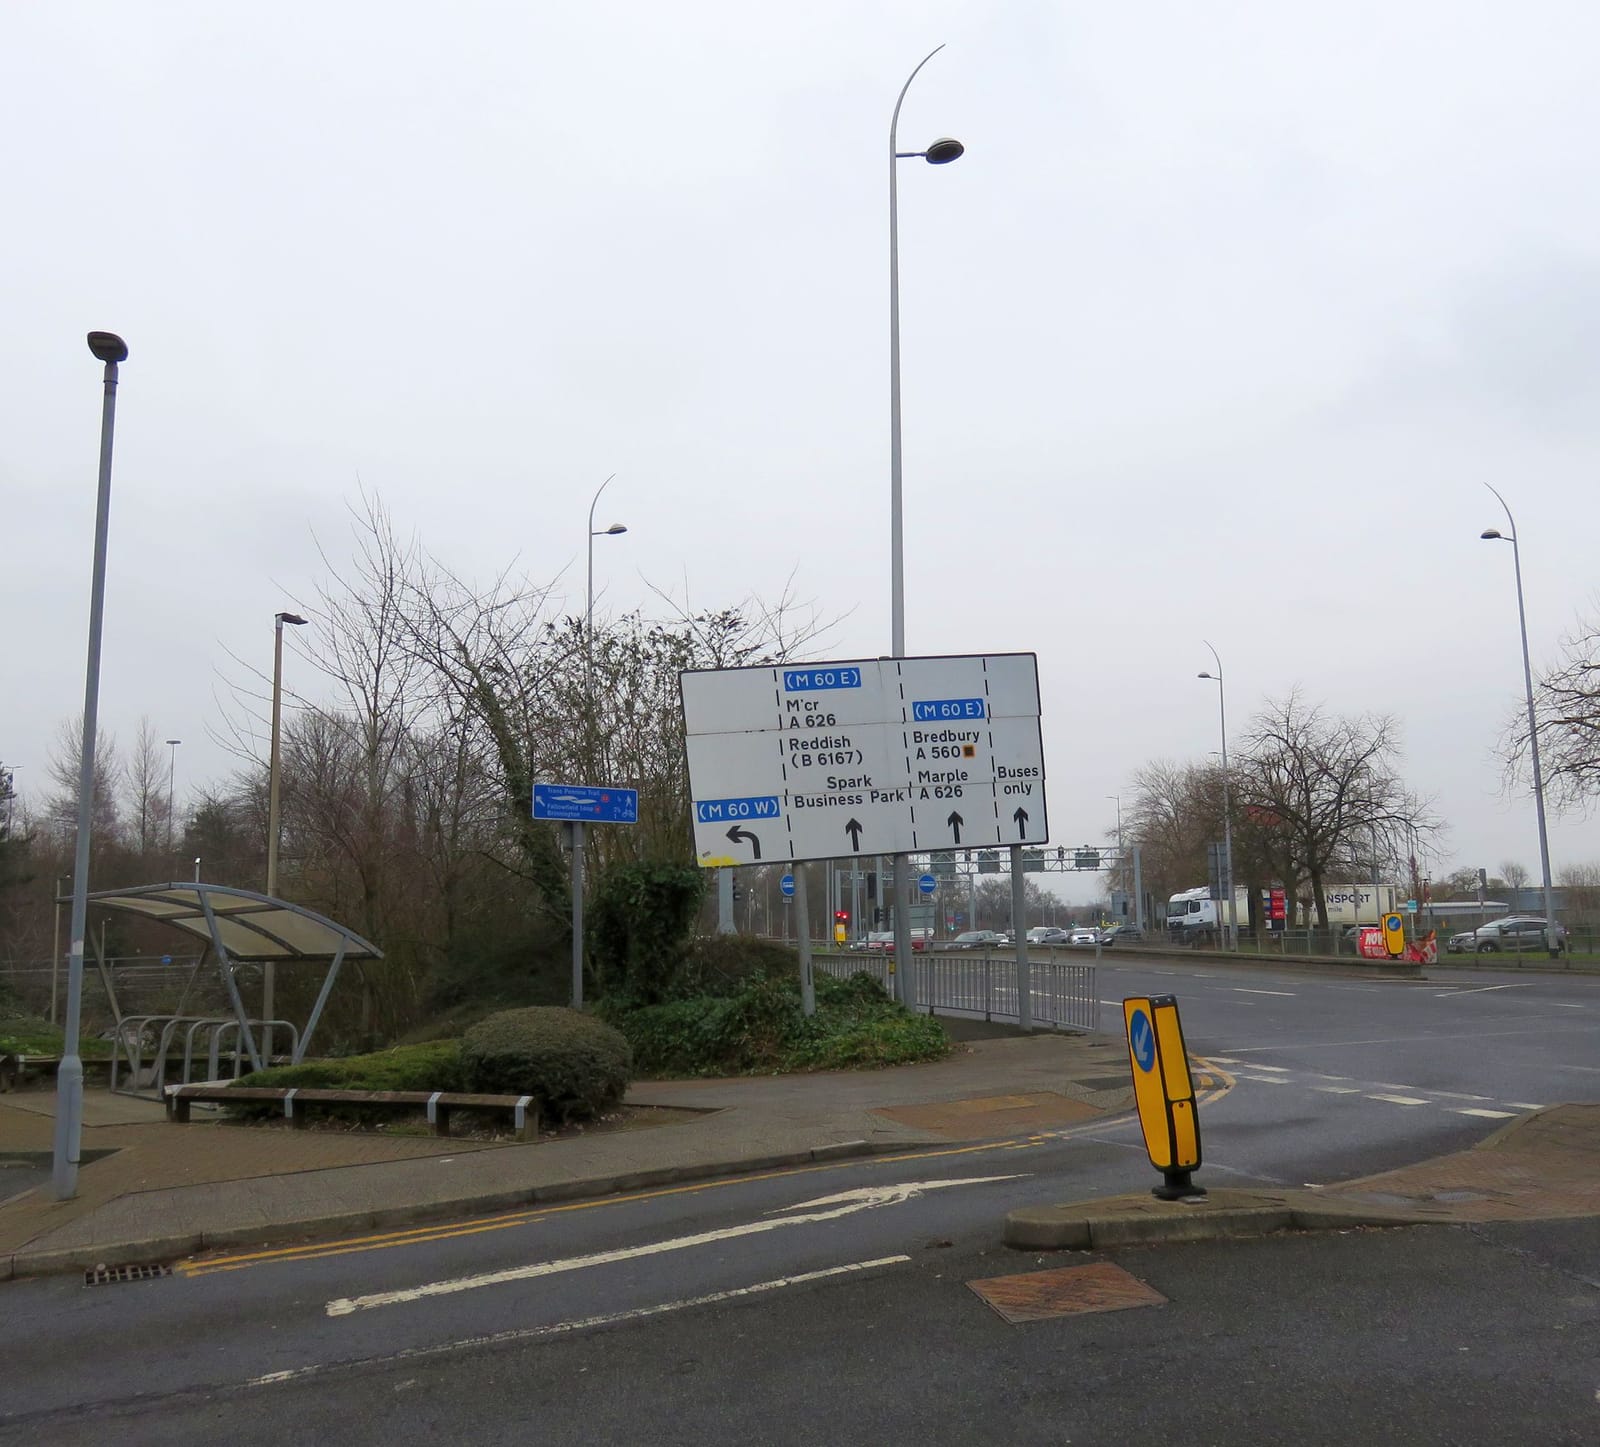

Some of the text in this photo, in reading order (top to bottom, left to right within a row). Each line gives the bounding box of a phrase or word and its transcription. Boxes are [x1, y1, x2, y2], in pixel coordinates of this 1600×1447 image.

[786, 669, 859, 689] (M 60 E)
[787, 699, 819, 712] M'cr
[915, 700, 983, 719] (M 60 E)
[790, 714, 836, 728] A 626
[790, 736, 851, 751] Reddish
[914, 729, 980, 745] Bredbury
[817, 749, 863, 766] 6167)
[916, 745, 961, 759] A 560
[919, 770, 968, 786] Marple
[998, 765, 1038, 779] Buses
[827, 775, 872, 790] Spark
[1004, 782, 1032, 797] only
[795, 789, 904, 808] Business Park
[920, 786, 963, 800] A 626
[699, 799, 778, 820] (M 60 W)
[1327, 894, 1370, 903] NSPORT
